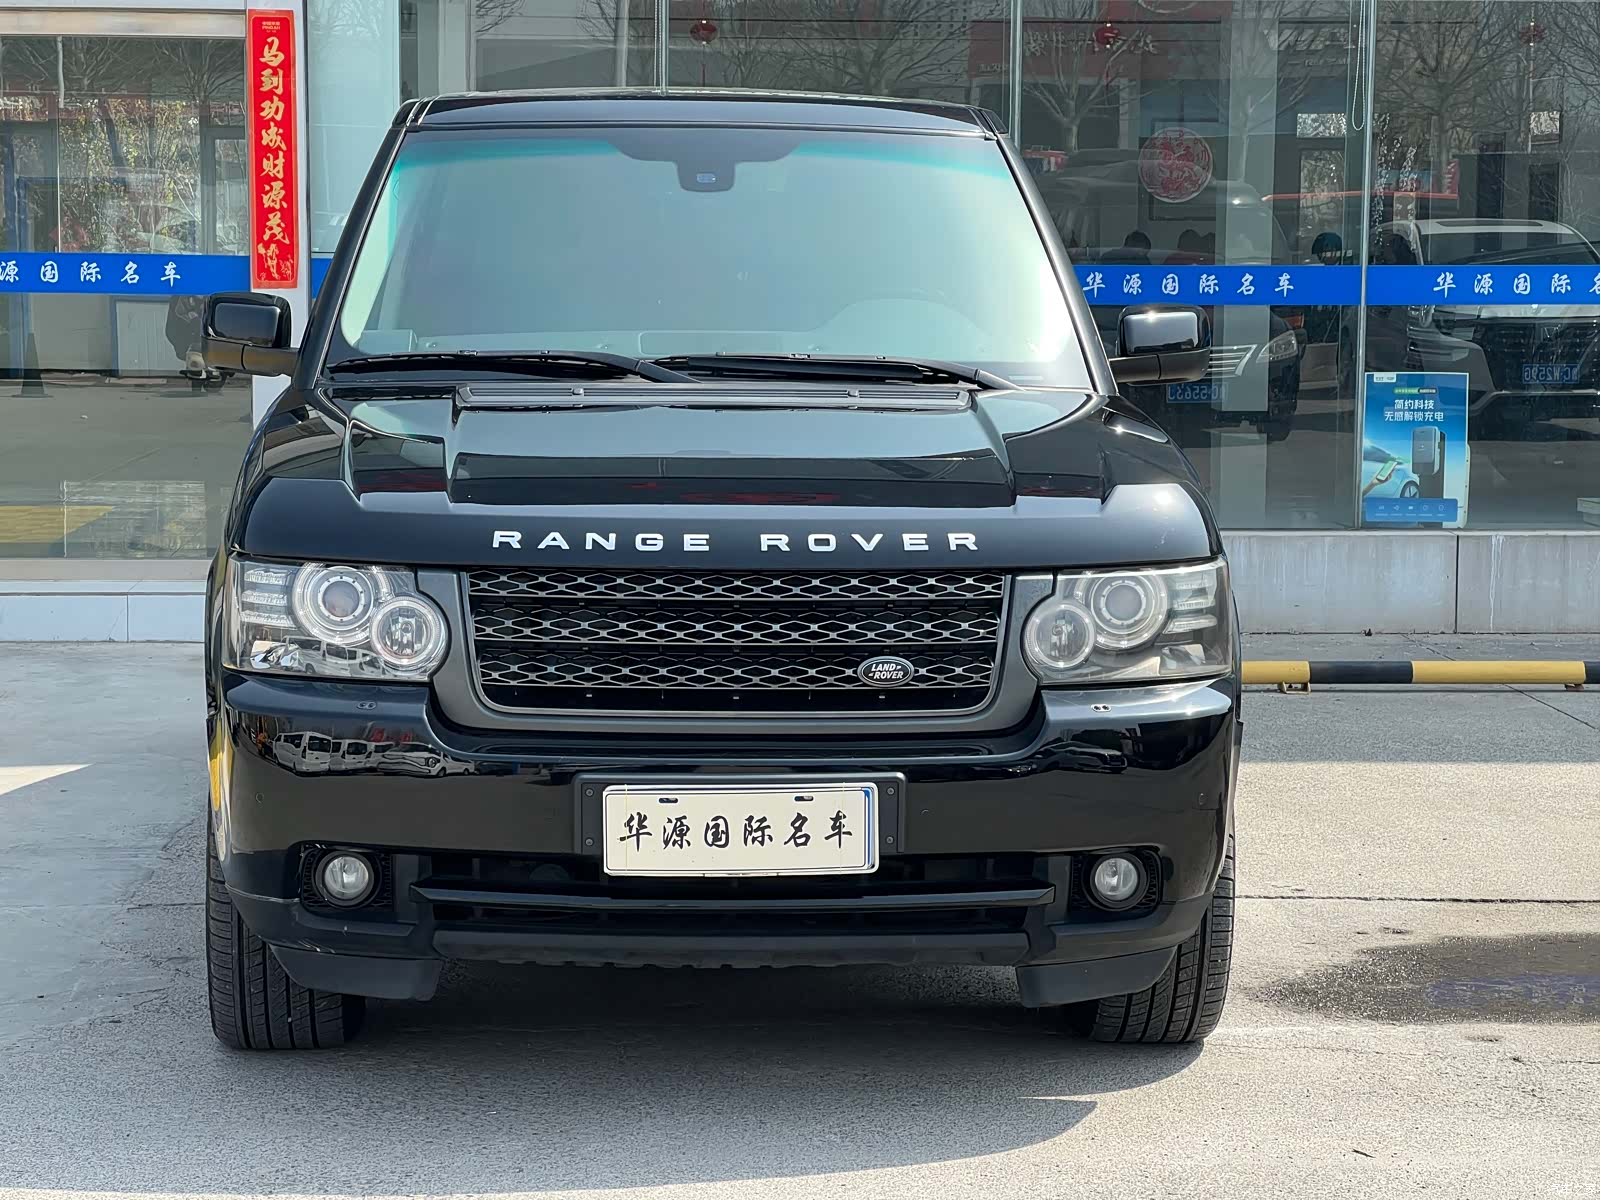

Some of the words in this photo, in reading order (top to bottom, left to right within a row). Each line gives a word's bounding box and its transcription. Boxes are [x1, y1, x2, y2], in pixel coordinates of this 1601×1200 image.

[259, 36, 290, 245] 马到功成财源茂
[1083, 271, 1294, 298] 华源国际名车
[1394, 400, 1434, 410] 简约科技
[1384, 411, 1444, 422] 无感解锁充电
[492, 530, 710, 551] RANGE
[760, 532, 978, 552] ROVER
[871, 663, 896, 671] LAND
[873, 671, 904, 679] ROVER
[618, 810, 853, 852] 华源国际名车
